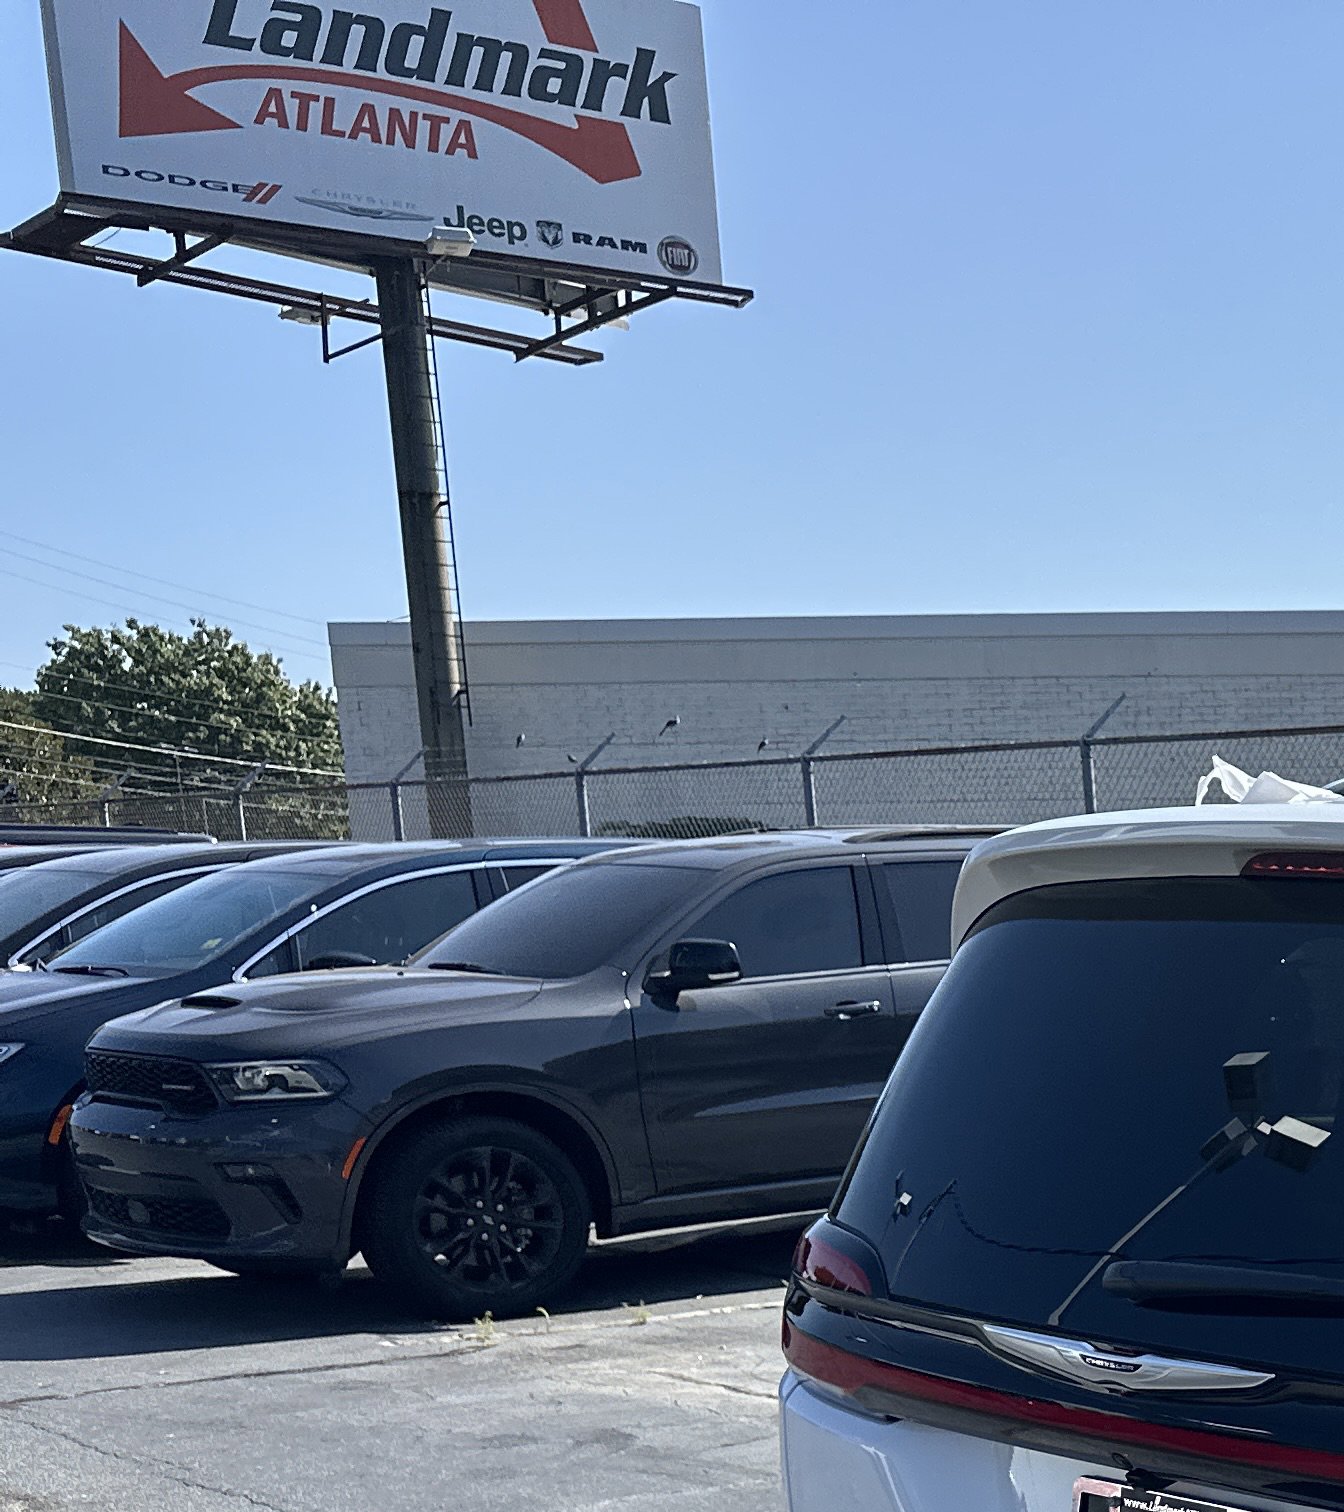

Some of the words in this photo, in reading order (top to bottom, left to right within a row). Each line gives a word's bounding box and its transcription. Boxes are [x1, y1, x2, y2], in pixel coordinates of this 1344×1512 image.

[202, 0, 679, 125] Landmark
[253, 87, 479, 159] ATLANTA
[101, 164, 257, 195] DODGE
[443, 205, 528, 245] Jeep
[572, 231, 649, 254] RAM
